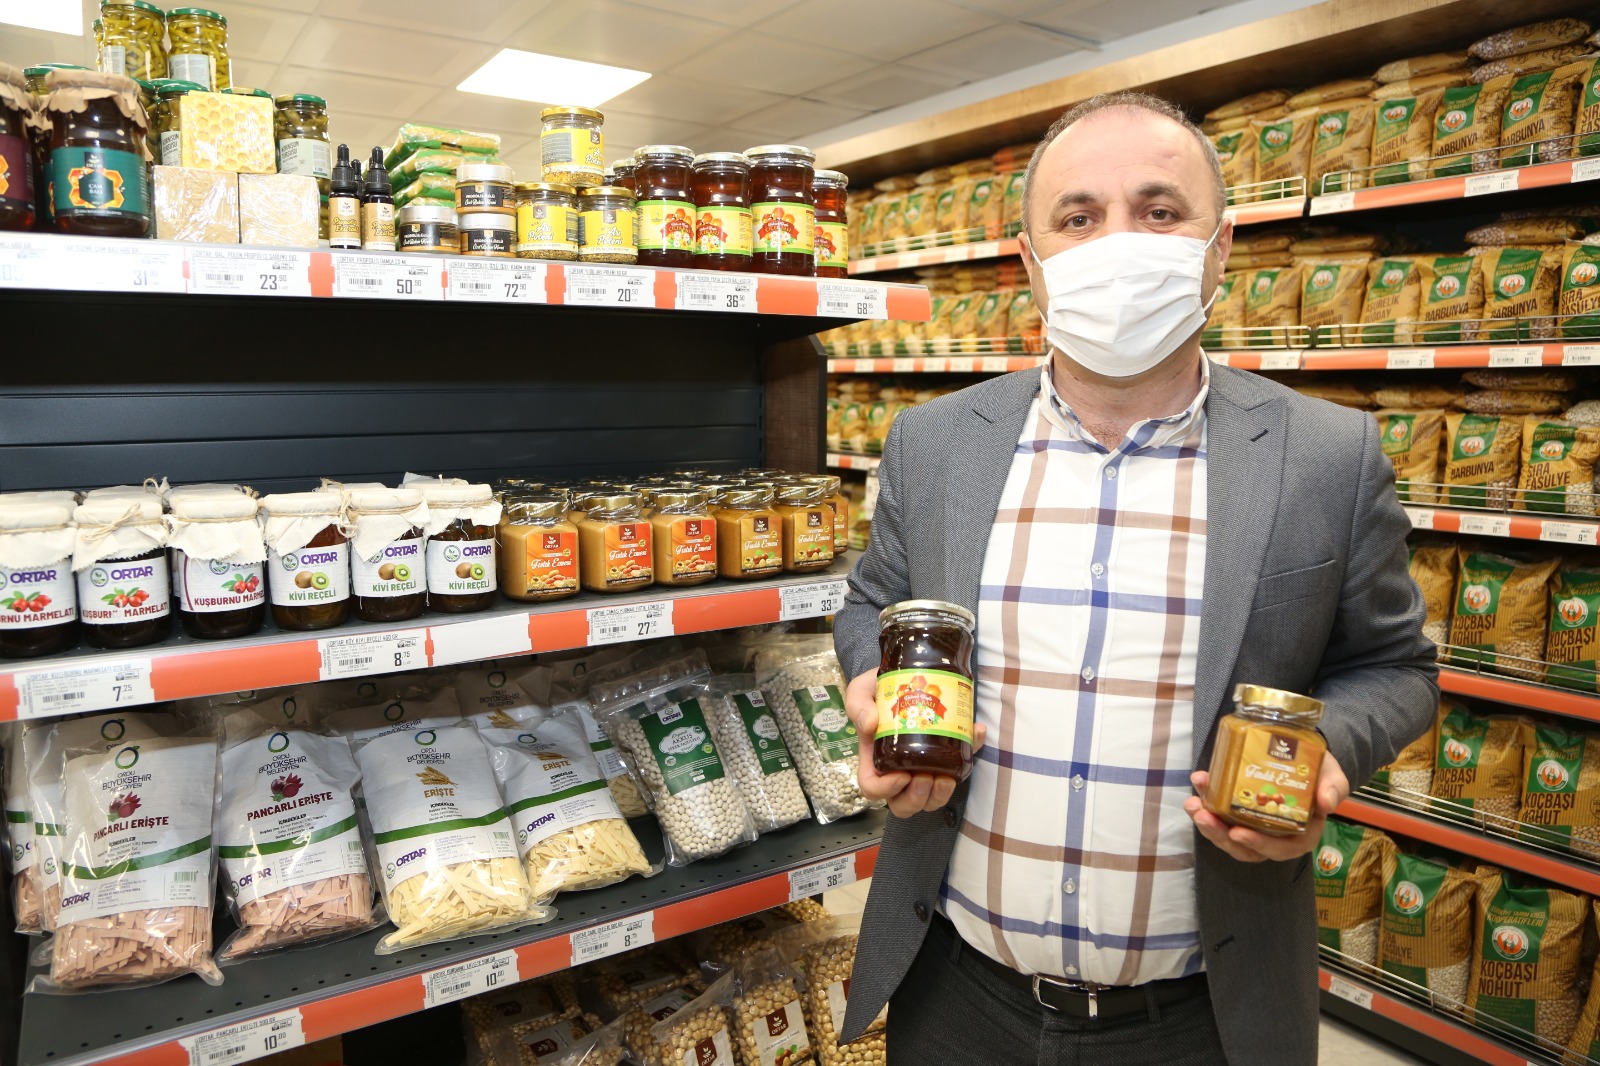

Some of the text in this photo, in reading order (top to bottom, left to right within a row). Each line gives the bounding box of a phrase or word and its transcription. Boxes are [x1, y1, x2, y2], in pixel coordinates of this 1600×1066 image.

[260, 275, 278, 290] 23
[397, 279, 413, 294] 50
[504, 283, 518, 298] 72
[618, 288, 631, 302] 20
[726, 295, 739, 308] 36
[857, 302, 868, 314] 68
[1562, 297, 1600, 320] FASULY
[1451, 461, 1494, 480] BARBUNYA
[1526, 471, 1571, 490] FASULYE
[385, 545, 417, 557] ORTAR
[463, 545, 491, 556] ORTAR
[301, 552, 337, 564] ORTAR
[10, 570, 57, 583] ORTAR
[111, 565, 153, 580] ORTAR
[373, 581, 416, 593] KİVİ REÇELİ
[449, 581, 490, 590] KİVİ REÇELİ
[194, 596, 242, 607] KUŞBURNU
[289, 588, 336, 601] KİVİ REÇELİ
[821, 599, 832, 612] 33
[638, 622, 650, 635] 27
[1550, 627, 1596, 647] KOÇBAŞI
[394, 652, 402, 666] 8
[113, 686, 122, 702] 7
[1270, 750, 1293, 760] ORTAR
[543, 759, 571, 772] ERİŞTE
[424, 787, 454, 798] ERİŞTE
[247, 792, 333, 821] PANCARLI ERİŞTE
[1524, 794, 1575, 811] KOÇBAŞI
[94, 816, 169, 842] PANCARLI ERİŞTE
[527, 812, 556, 832] ORTAR
[396, 848, 427, 867] ORTAR
[239, 867, 272, 888] ORAR
[827, 874, 838, 887] 38
[62, 893, 90, 908] ORTAR
[624, 935, 631, 947] 8
[1480, 960, 1538, 983] KOÇBAŞI
[486, 972, 497, 986] 10
[1479, 978, 1523, 998] NOHUT
[771, 1024, 787, 1035] ORTAR
[264, 1035, 278, 1051] 10
